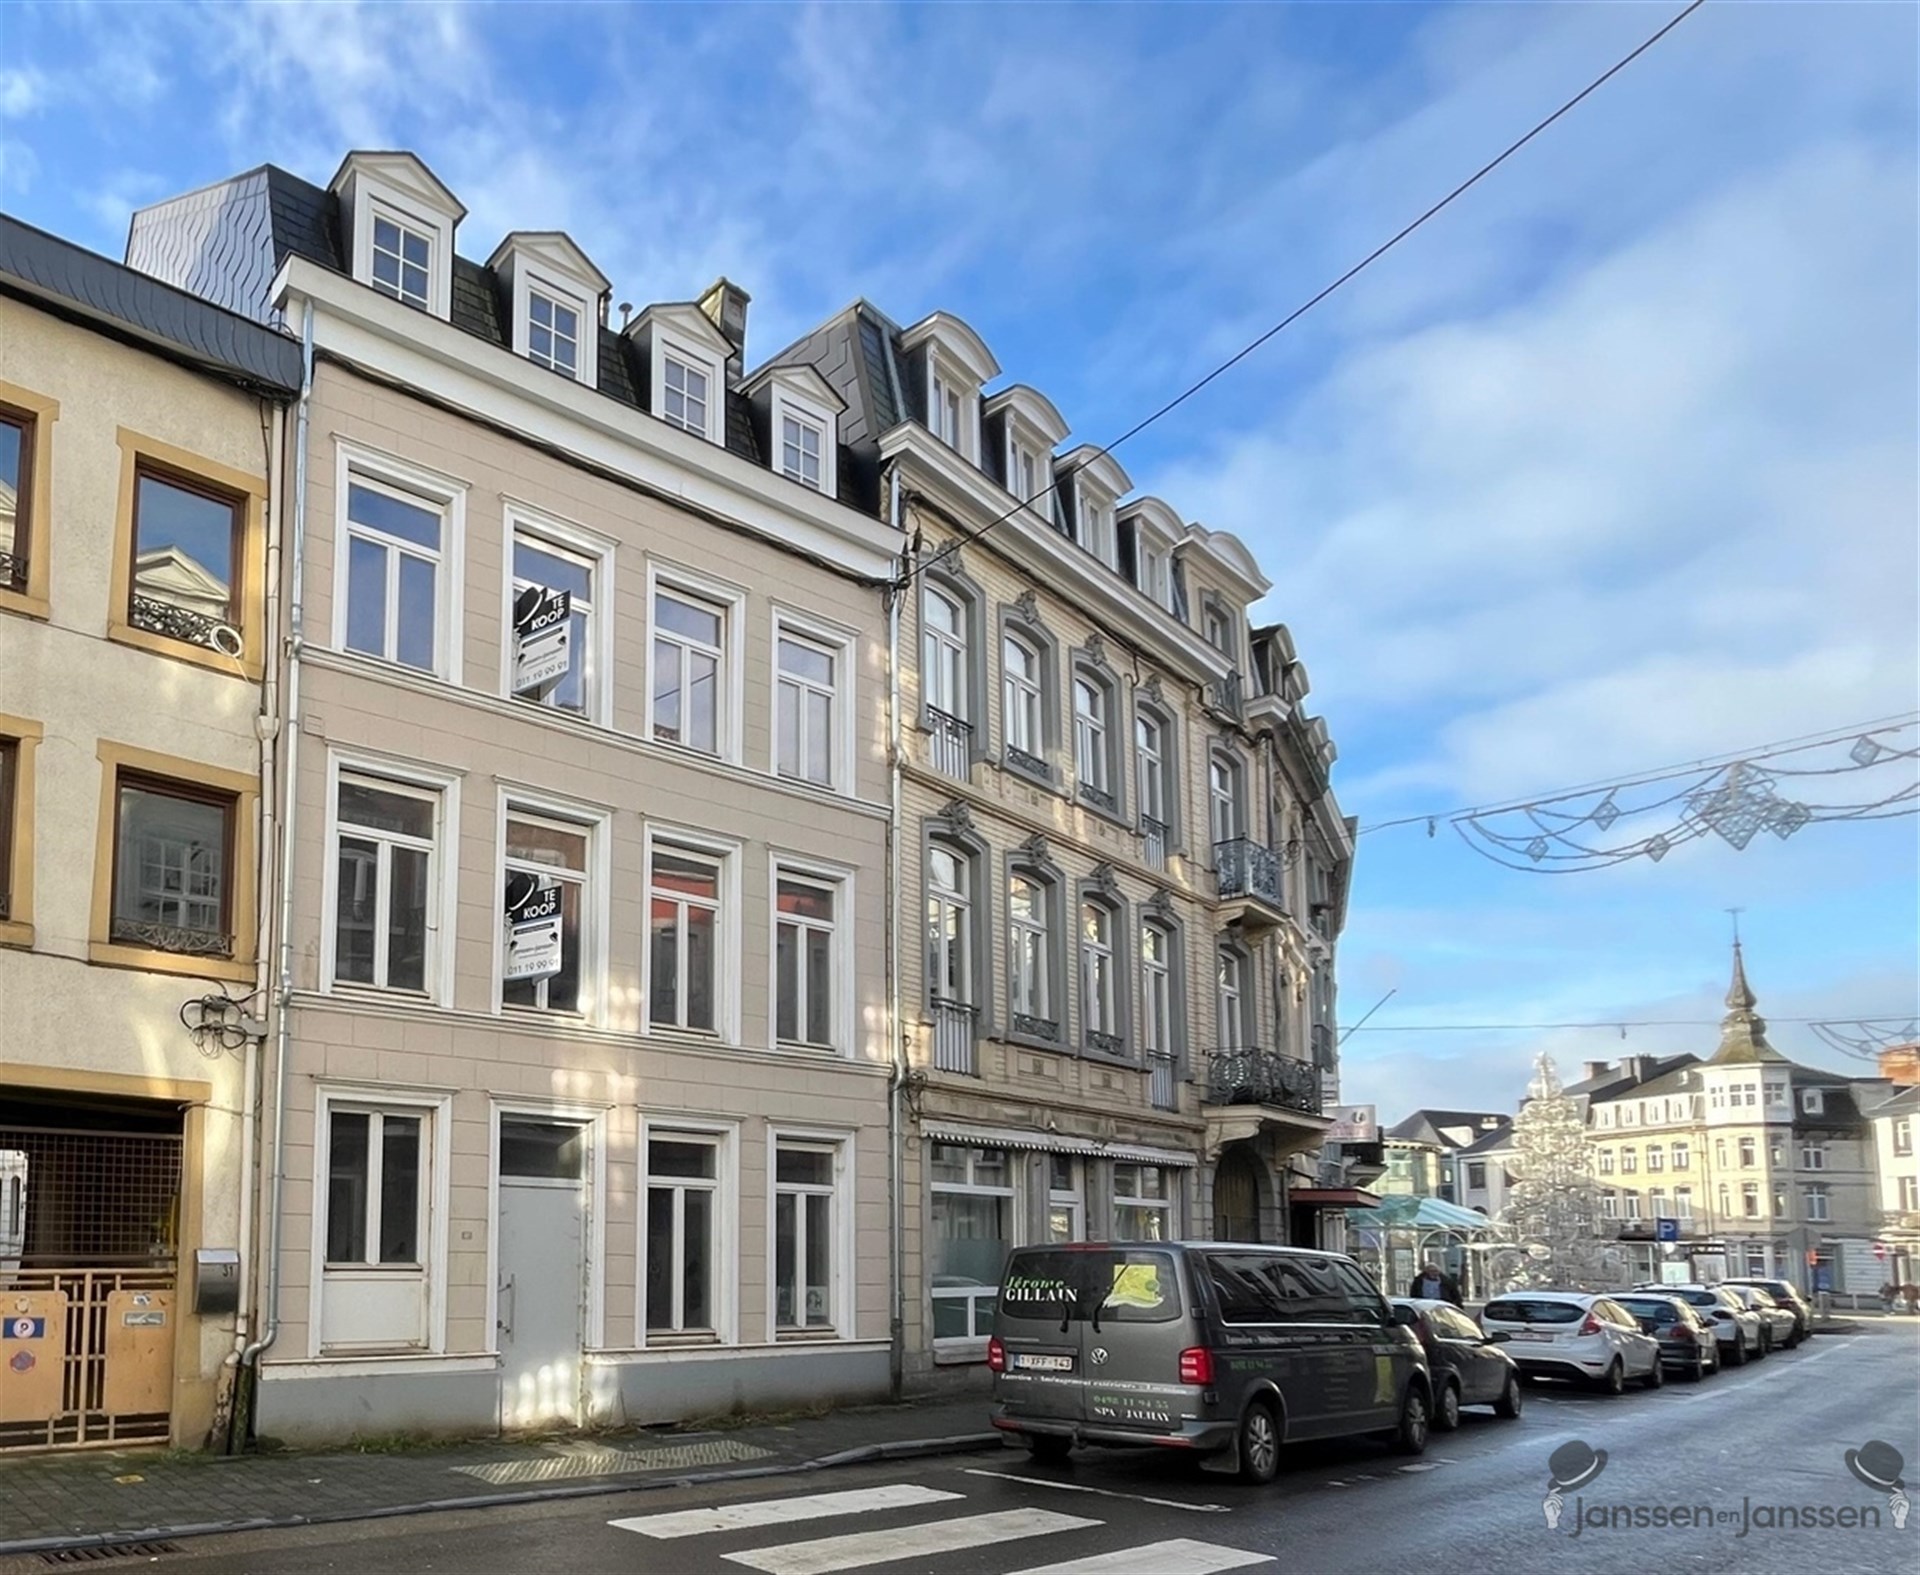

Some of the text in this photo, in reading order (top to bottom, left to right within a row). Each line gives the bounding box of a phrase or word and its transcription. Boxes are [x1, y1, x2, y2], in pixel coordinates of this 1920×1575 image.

[552, 595, 565, 609] TE
[531, 607, 565, 631] KOOP
[544, 889, 556, 902] TE
[523, 902, 556, 920] KOOP
[1660, 1222, 1675, 1238] P
[222, 1264, 234, 1278] 31
[1005, 1288, 1078, 1302] GILLAIN
[1094, 1407, 1116, 1418] SPA
